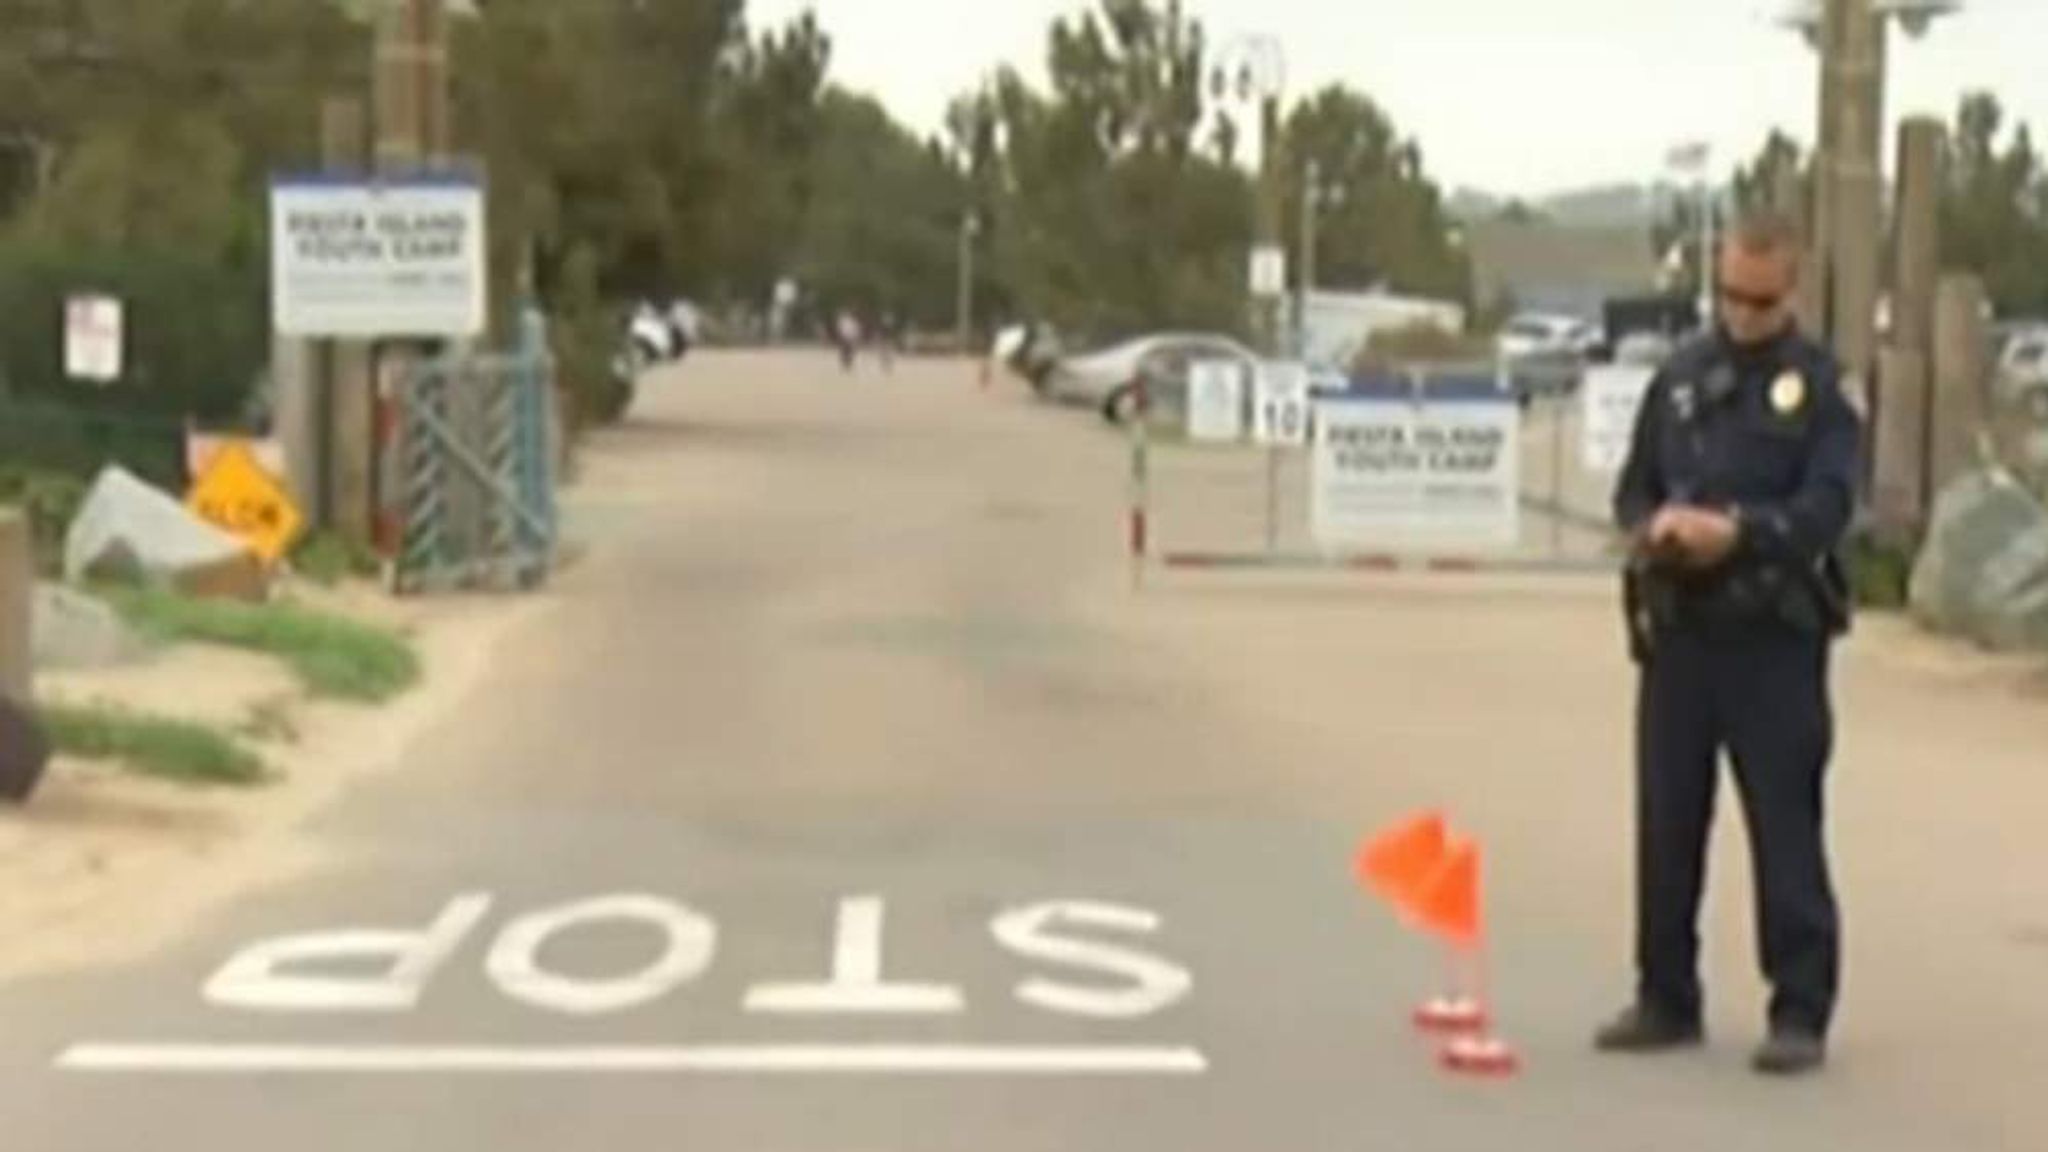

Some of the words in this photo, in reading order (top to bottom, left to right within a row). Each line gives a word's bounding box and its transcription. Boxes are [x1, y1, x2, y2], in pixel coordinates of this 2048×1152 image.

[296, 238, 382, 261] YOUTH
[392, 238, 460, 260] CAMP
[1265, 401, 1299, 437] 10
[1335, 450, 1420, 471] YOUTH
[1428, 450, 1497, 472] CAMP
[202, 892, 1194, 1015] STOP
